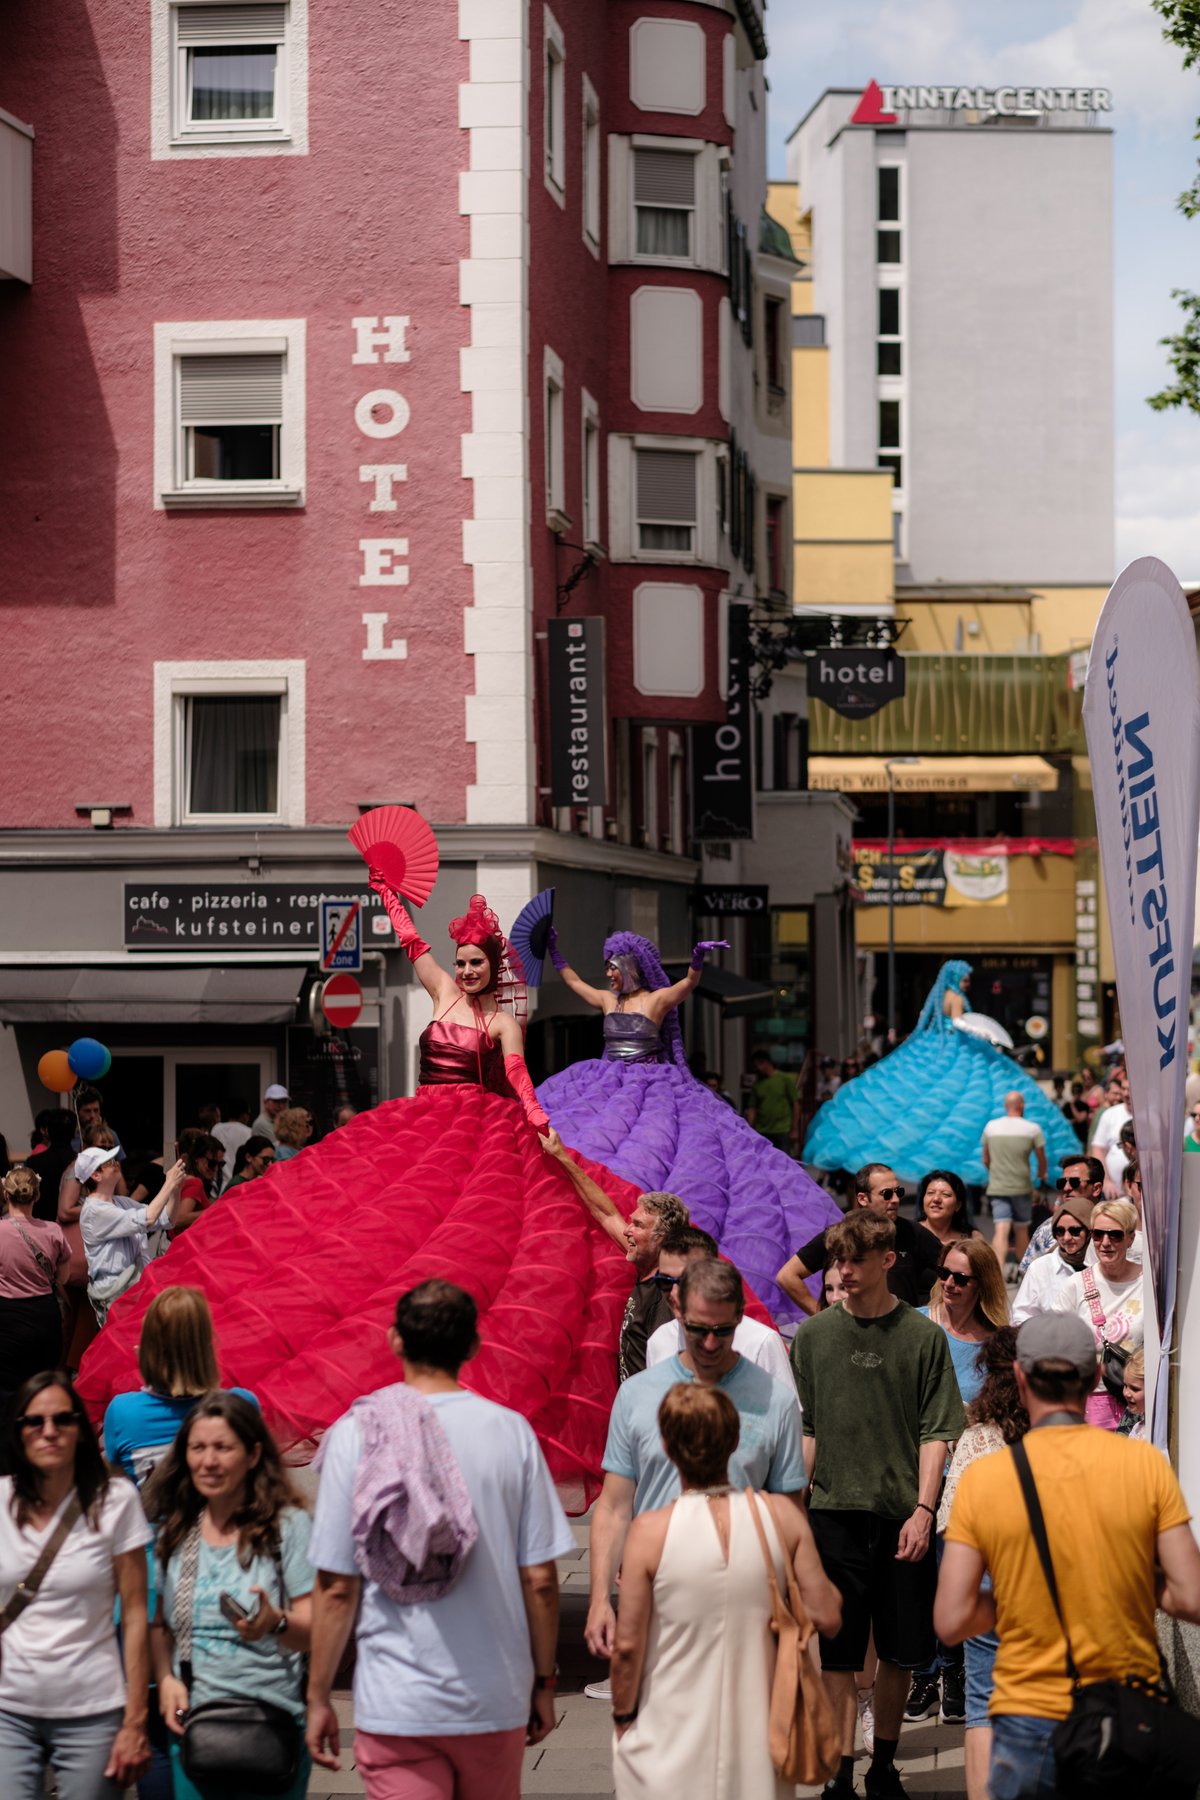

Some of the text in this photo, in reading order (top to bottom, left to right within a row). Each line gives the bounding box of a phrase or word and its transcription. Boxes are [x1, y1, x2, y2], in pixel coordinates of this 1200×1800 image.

[351, 315, 411, 660] HOTEL
[820, 659, 894, 684] hotel
[565, 642, 590, 803] restaurant
[811, 774, 969, 788] zlich Wilkommen
[129, 891, 383, 912] cafe pizzeria resan
[704, 895, 764, 911] VERO
[175, 917, 315, 936] kufsteiner
[343, 934, 355, 948] 20
